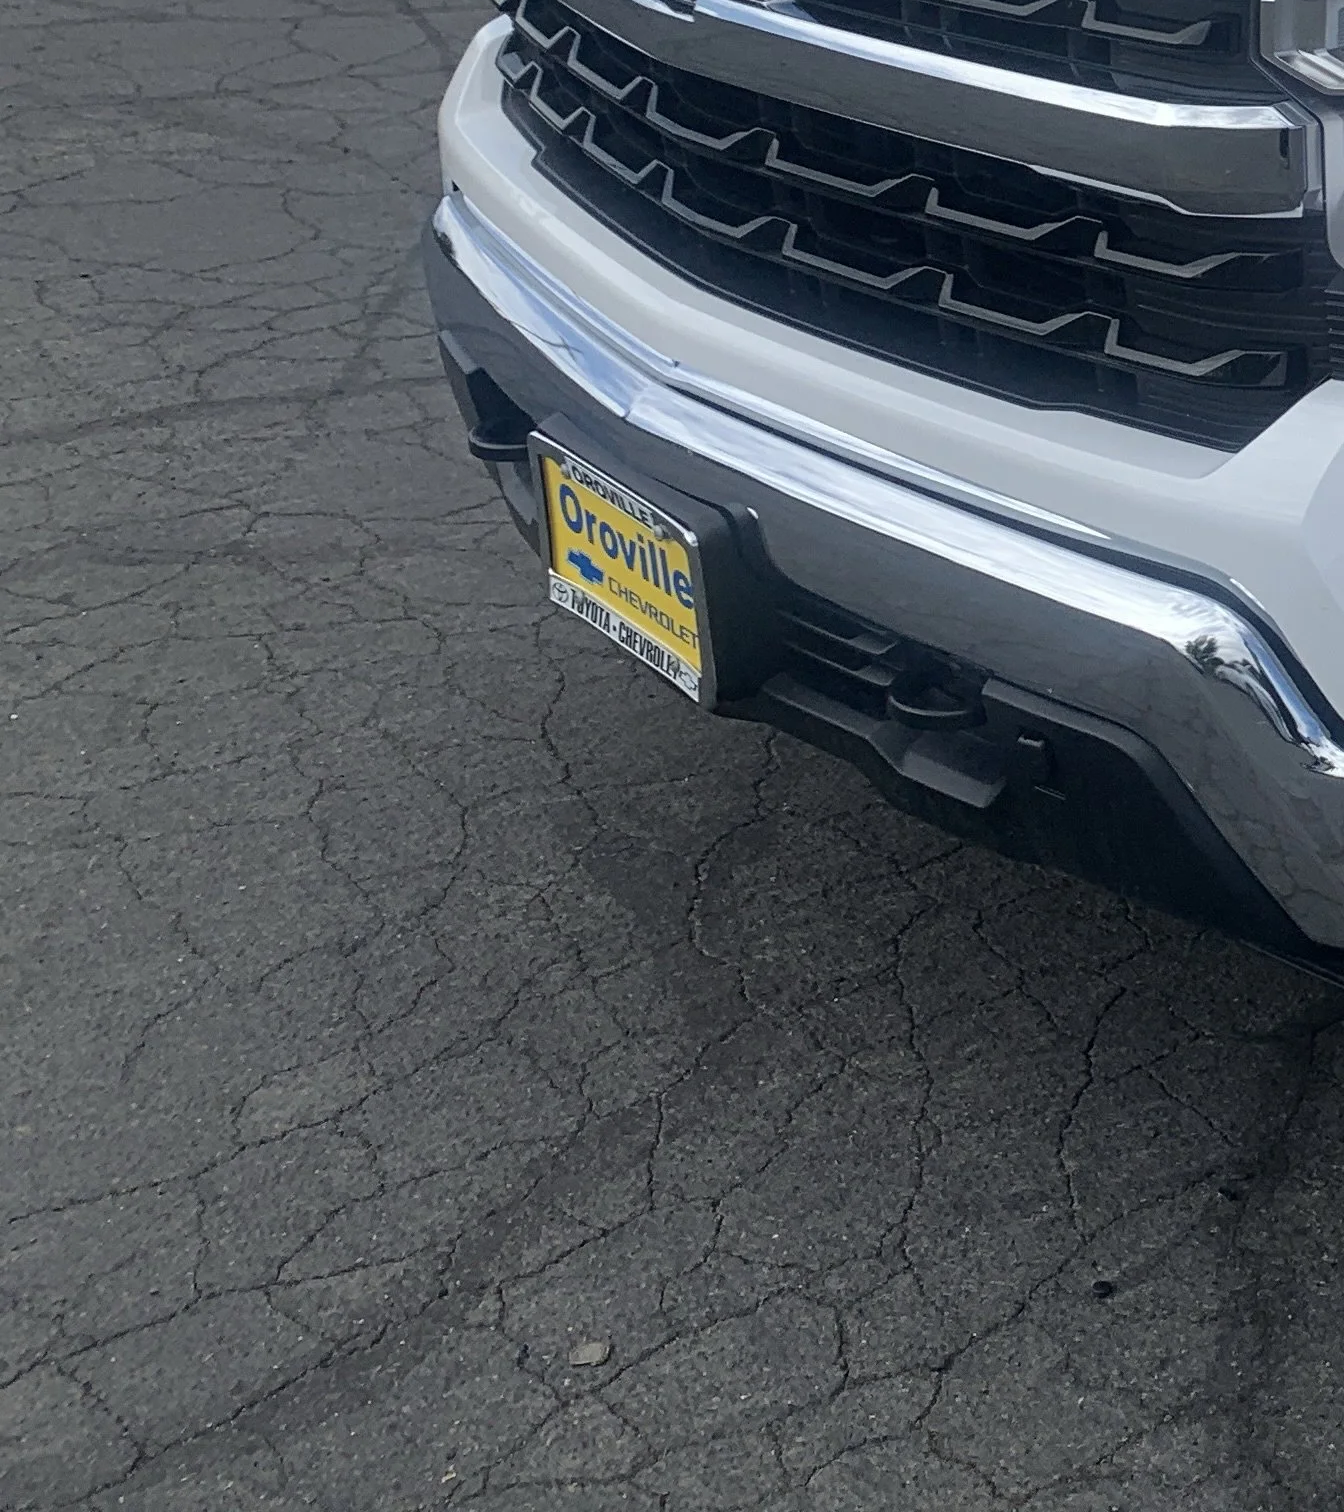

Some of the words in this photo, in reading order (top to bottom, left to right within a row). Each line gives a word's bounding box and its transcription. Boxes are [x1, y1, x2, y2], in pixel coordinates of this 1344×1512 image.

[571, 465, 656, 528] OROVILLE
[558, 483, 694, 610] Oroville
[608, 576, 699, 649] CHEVROLET
